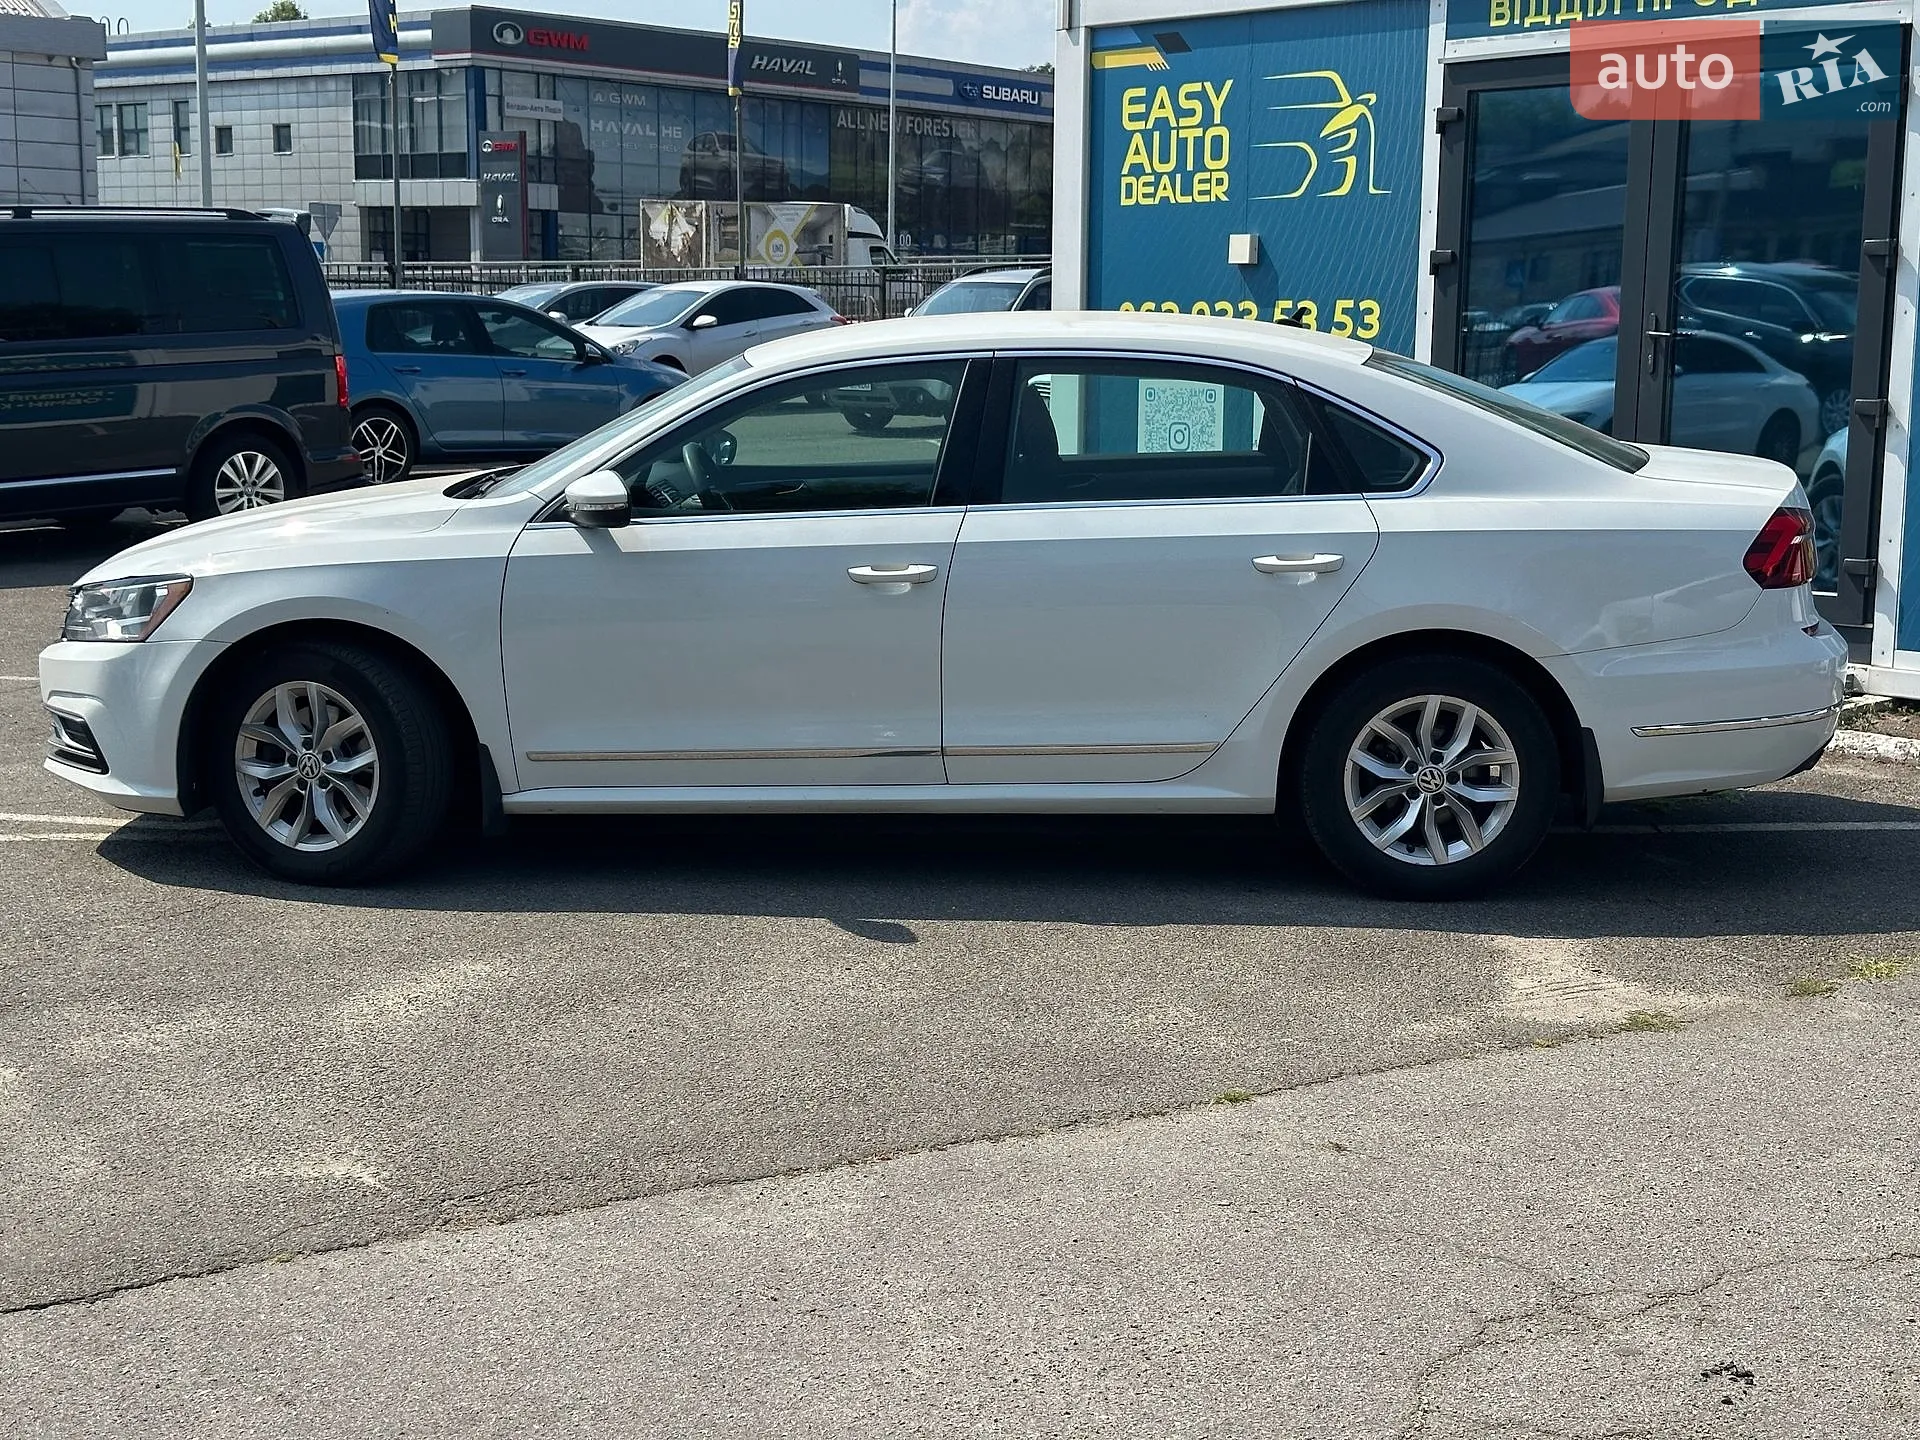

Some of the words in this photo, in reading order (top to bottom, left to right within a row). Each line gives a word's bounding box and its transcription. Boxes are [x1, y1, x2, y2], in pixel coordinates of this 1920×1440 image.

[527, 28, 590, 51] GWM
[751, 55, 816, 76] HAVAL
[609, 92, 646, 106] GWM
[982, 85, 1039, 105] SUBARU
[1121, 79, 1233, 131] EASY
[590, 119, 656, 136] HAVAL
[661, 125, 682, 138] H6
[837, 110, 865, 129] ALL
[906, 116, 976, 138] FORESTER
[1121, 126, 1230, 175] AUTO
[482, 172, 519, 182] HAVAL
[1120, 171, 1229, 206] DEALER
[1330, 299, 1380, 339] 53
